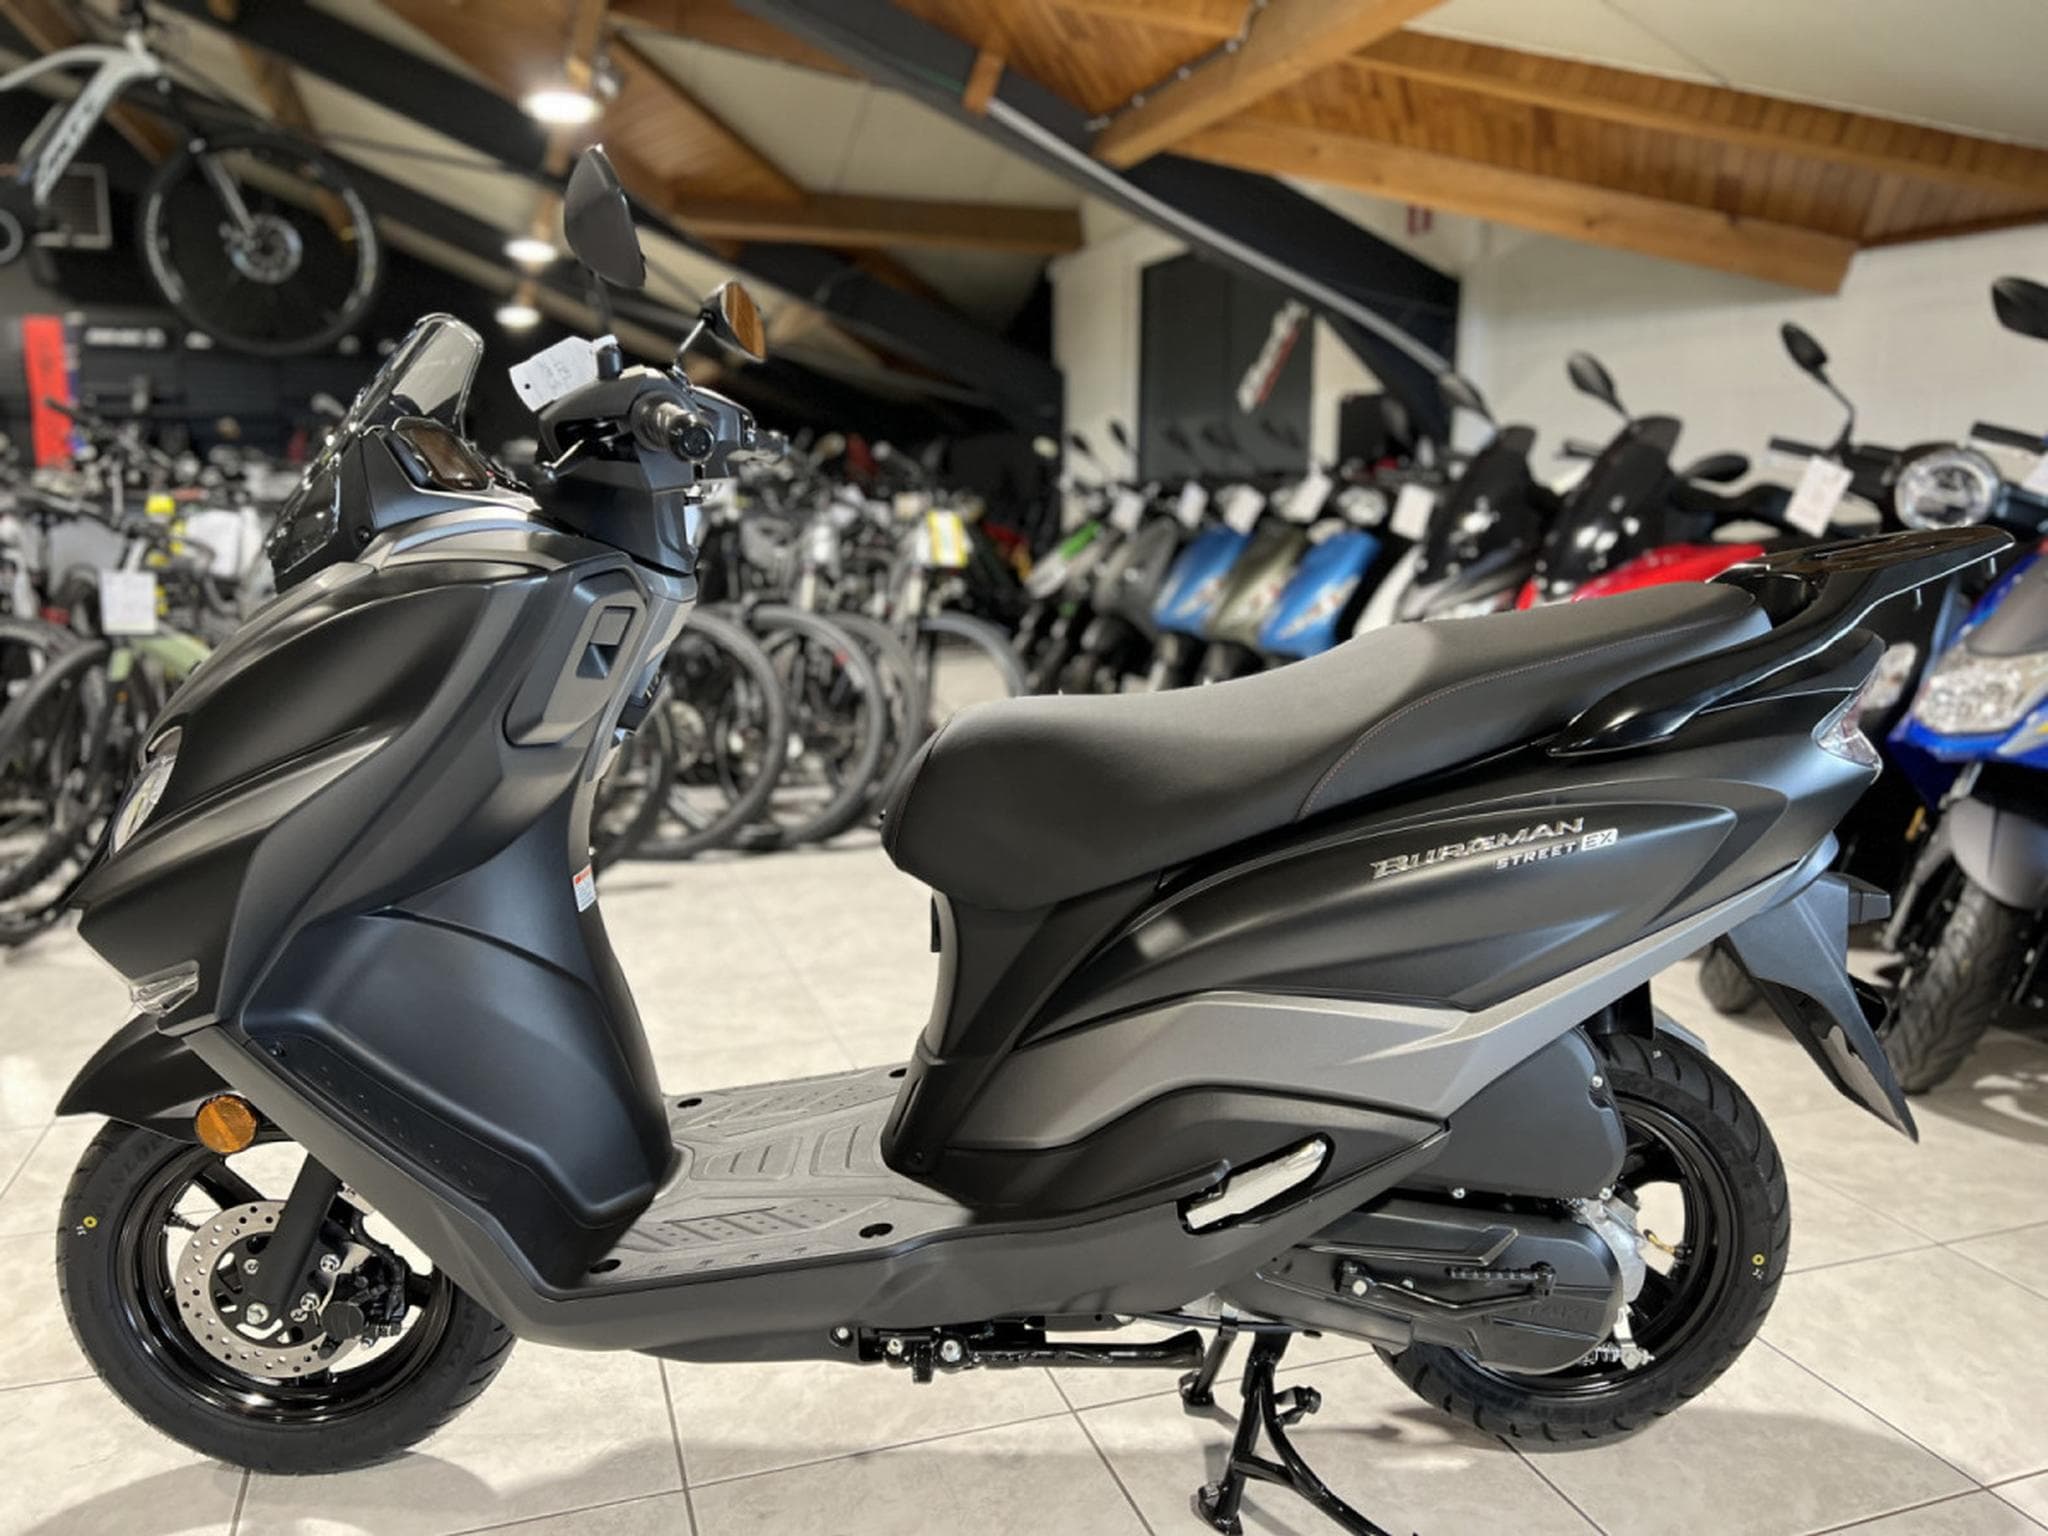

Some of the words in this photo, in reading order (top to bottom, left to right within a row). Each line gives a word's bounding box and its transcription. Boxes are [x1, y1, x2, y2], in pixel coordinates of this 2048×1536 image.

[1369, 817, 1584, 879] BURGMAN
[1495, 841, 1577, 870] STREET
[1583, 830, 1616, 850] EX
